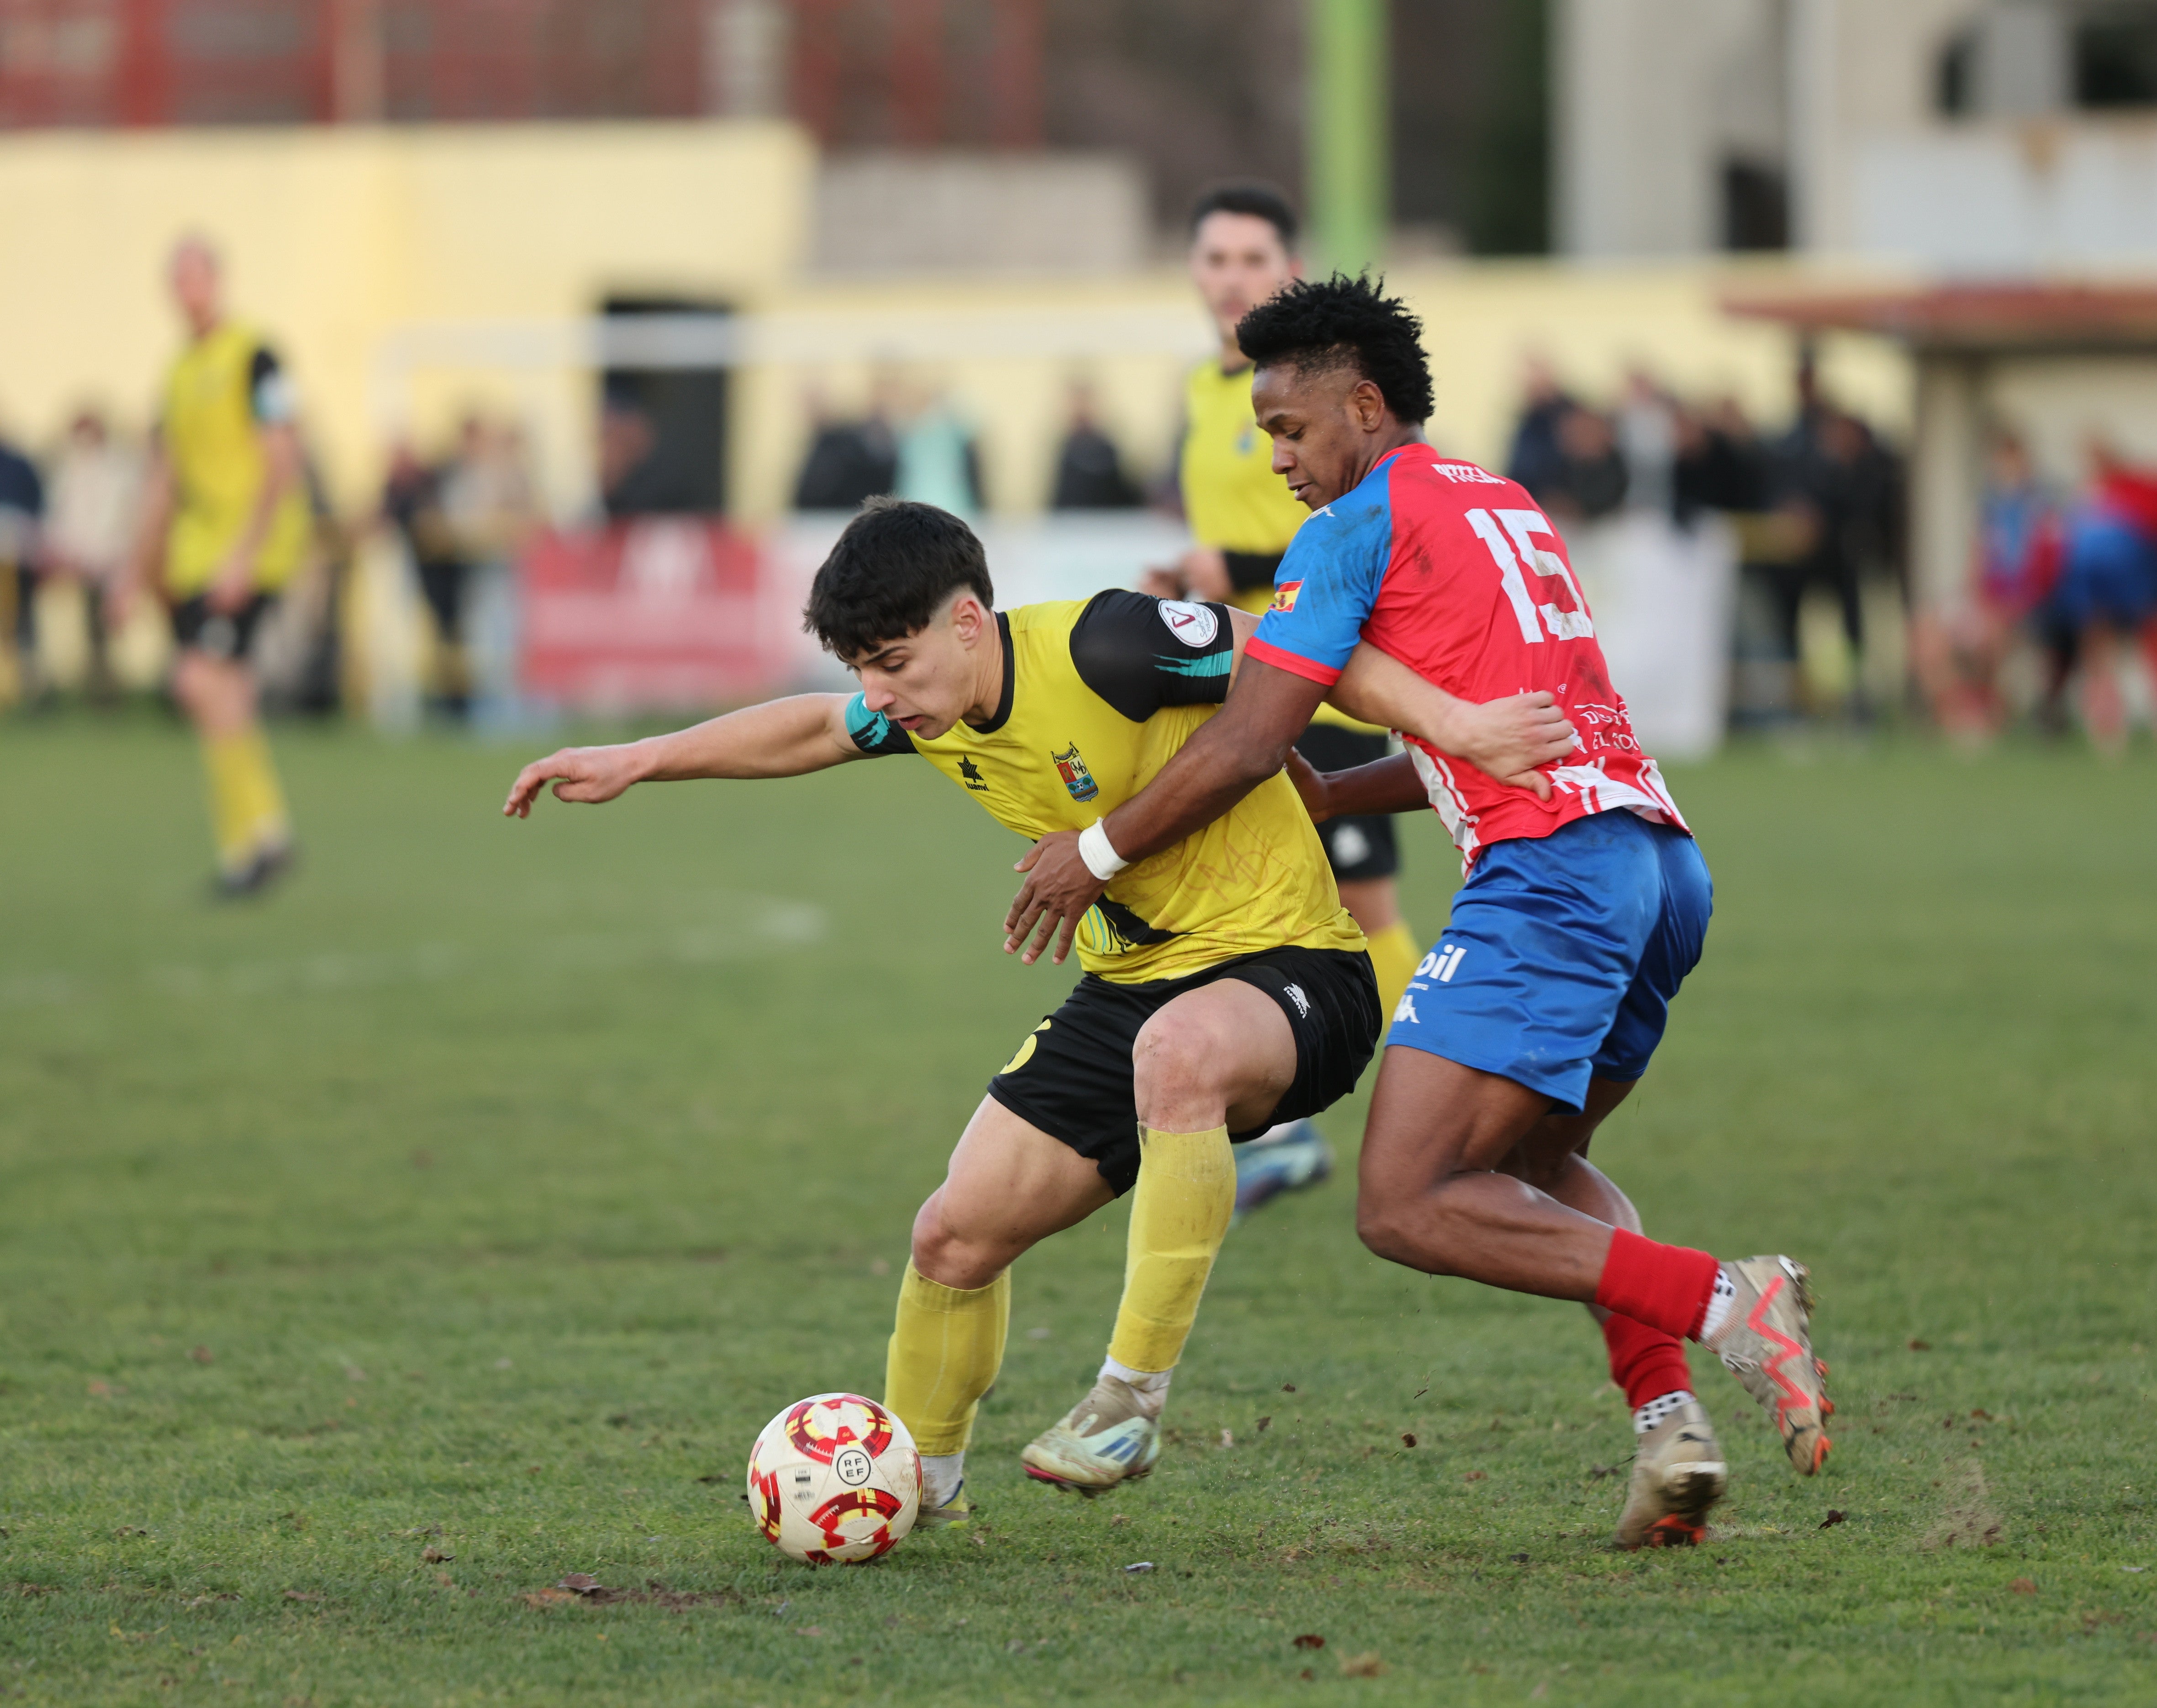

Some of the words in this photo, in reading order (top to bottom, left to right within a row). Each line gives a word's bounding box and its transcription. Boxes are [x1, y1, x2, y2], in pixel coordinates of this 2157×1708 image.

[1464, 508, 1595, 643] 15
[965, 781, 990, 791] luanvi
[1283, 987, 1307, 1019] luanvi
